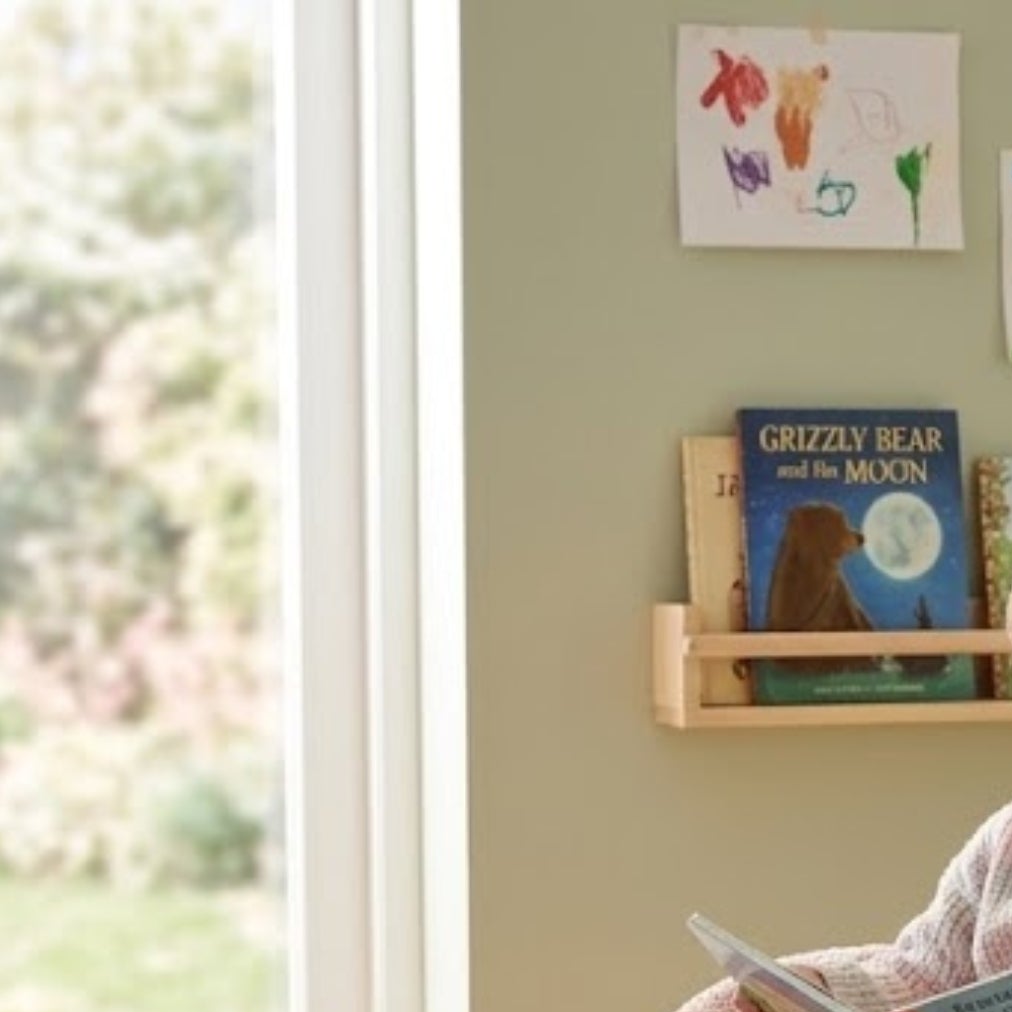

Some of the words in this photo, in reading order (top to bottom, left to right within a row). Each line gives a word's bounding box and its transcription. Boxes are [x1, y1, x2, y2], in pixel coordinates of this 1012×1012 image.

[758, 424, 868, 453] GRIZZLY
[875, 426, 944, 453] BEAR
[844, 457, 928, 485] MOON
